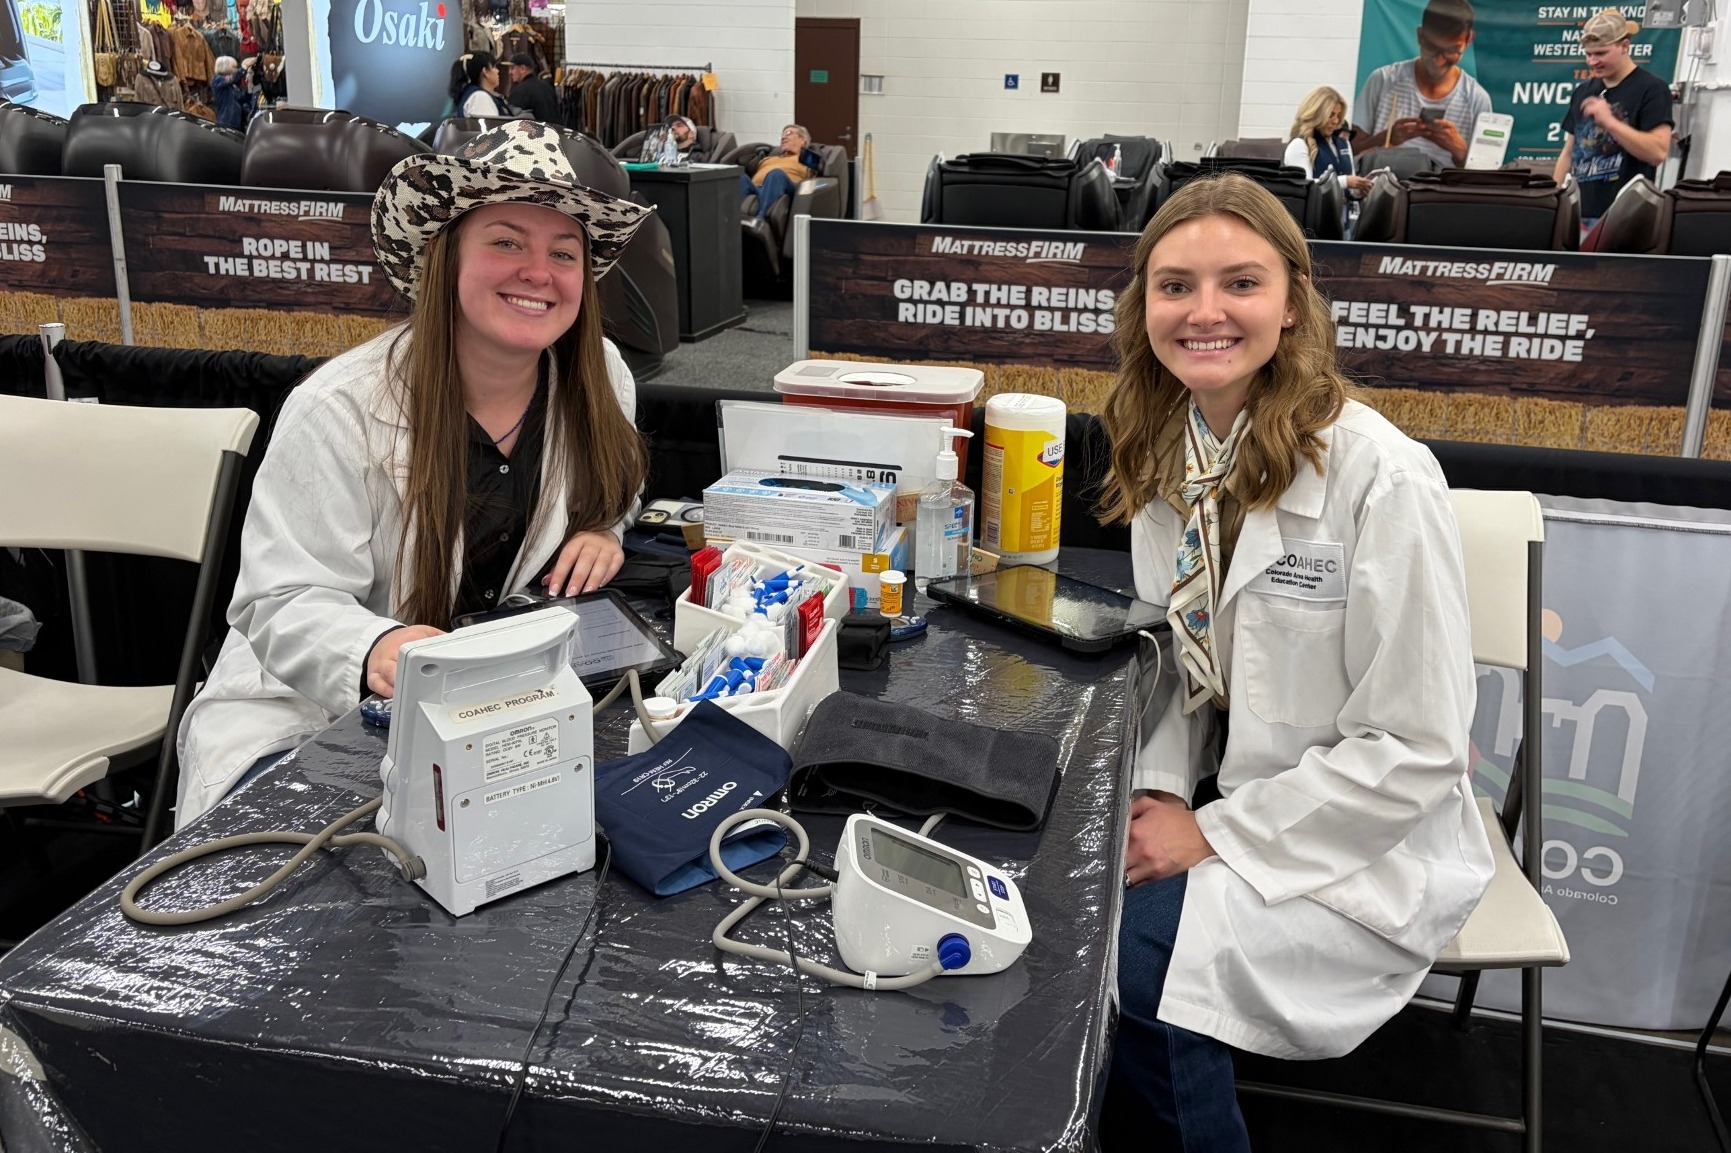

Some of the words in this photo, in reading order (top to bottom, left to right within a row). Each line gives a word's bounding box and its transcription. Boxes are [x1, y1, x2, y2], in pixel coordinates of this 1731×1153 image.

[1538, 6, 1570, 19] STAY
[1573, 7, 1587, 19] IN
[1619, 6, 1646, 18] KNO
[354, 0, 445, 51] Osaki
[1534, 44, 1586, 56] WESTER
[1629, 44, 1652, 56] TER
[1512, 82, 1575, 104] NWC
[0, 244, 46, 262] LISS
[242, 237, 303, 259] ROPE
[307, 241, 330, 260] IN
[204, 256, 250, 276] THE
[252, 259, 311, 280] BEST
[314, 263, 373, 284] REST
[893, 279, 968, 302] GRAB
[972, 283, 1027, 306] THE
[1031, 286, 1115, 310] REINS
[898, 302, 960, 326] RIDE
[965, 306, 1029, 329] INTO
[1033, 310, 1115, 334] BLISS
[1331, 300, 1405, 326] FEEL
[1409, 305, 1472, 330] THE
[1476, 309, 1596, 340] RELIEF,
[1336, 326, 1439, 353] ENJOY
[1442, 331, 1504, 357] THE
[1508, 337, 1585, 362] RIDE
[1047, 443, 1063, 457] USE
[1266, 568, 1292, 577] Colorado
[1293, 572, 1304, 580] Area
[1305, 574, 1323, 582] Health
[1271, 577, 1298, 586] Education
[459, 704, 501, 719] COAHEC
[505, 690, 556, 708] PROGRAM
[510, 726, 532, 736] OMRON
[517, 730, 537, 738] PRESSURE
[486, 790, 510, 802] BATTERY
[681, 781, 738, 819] OMRON
